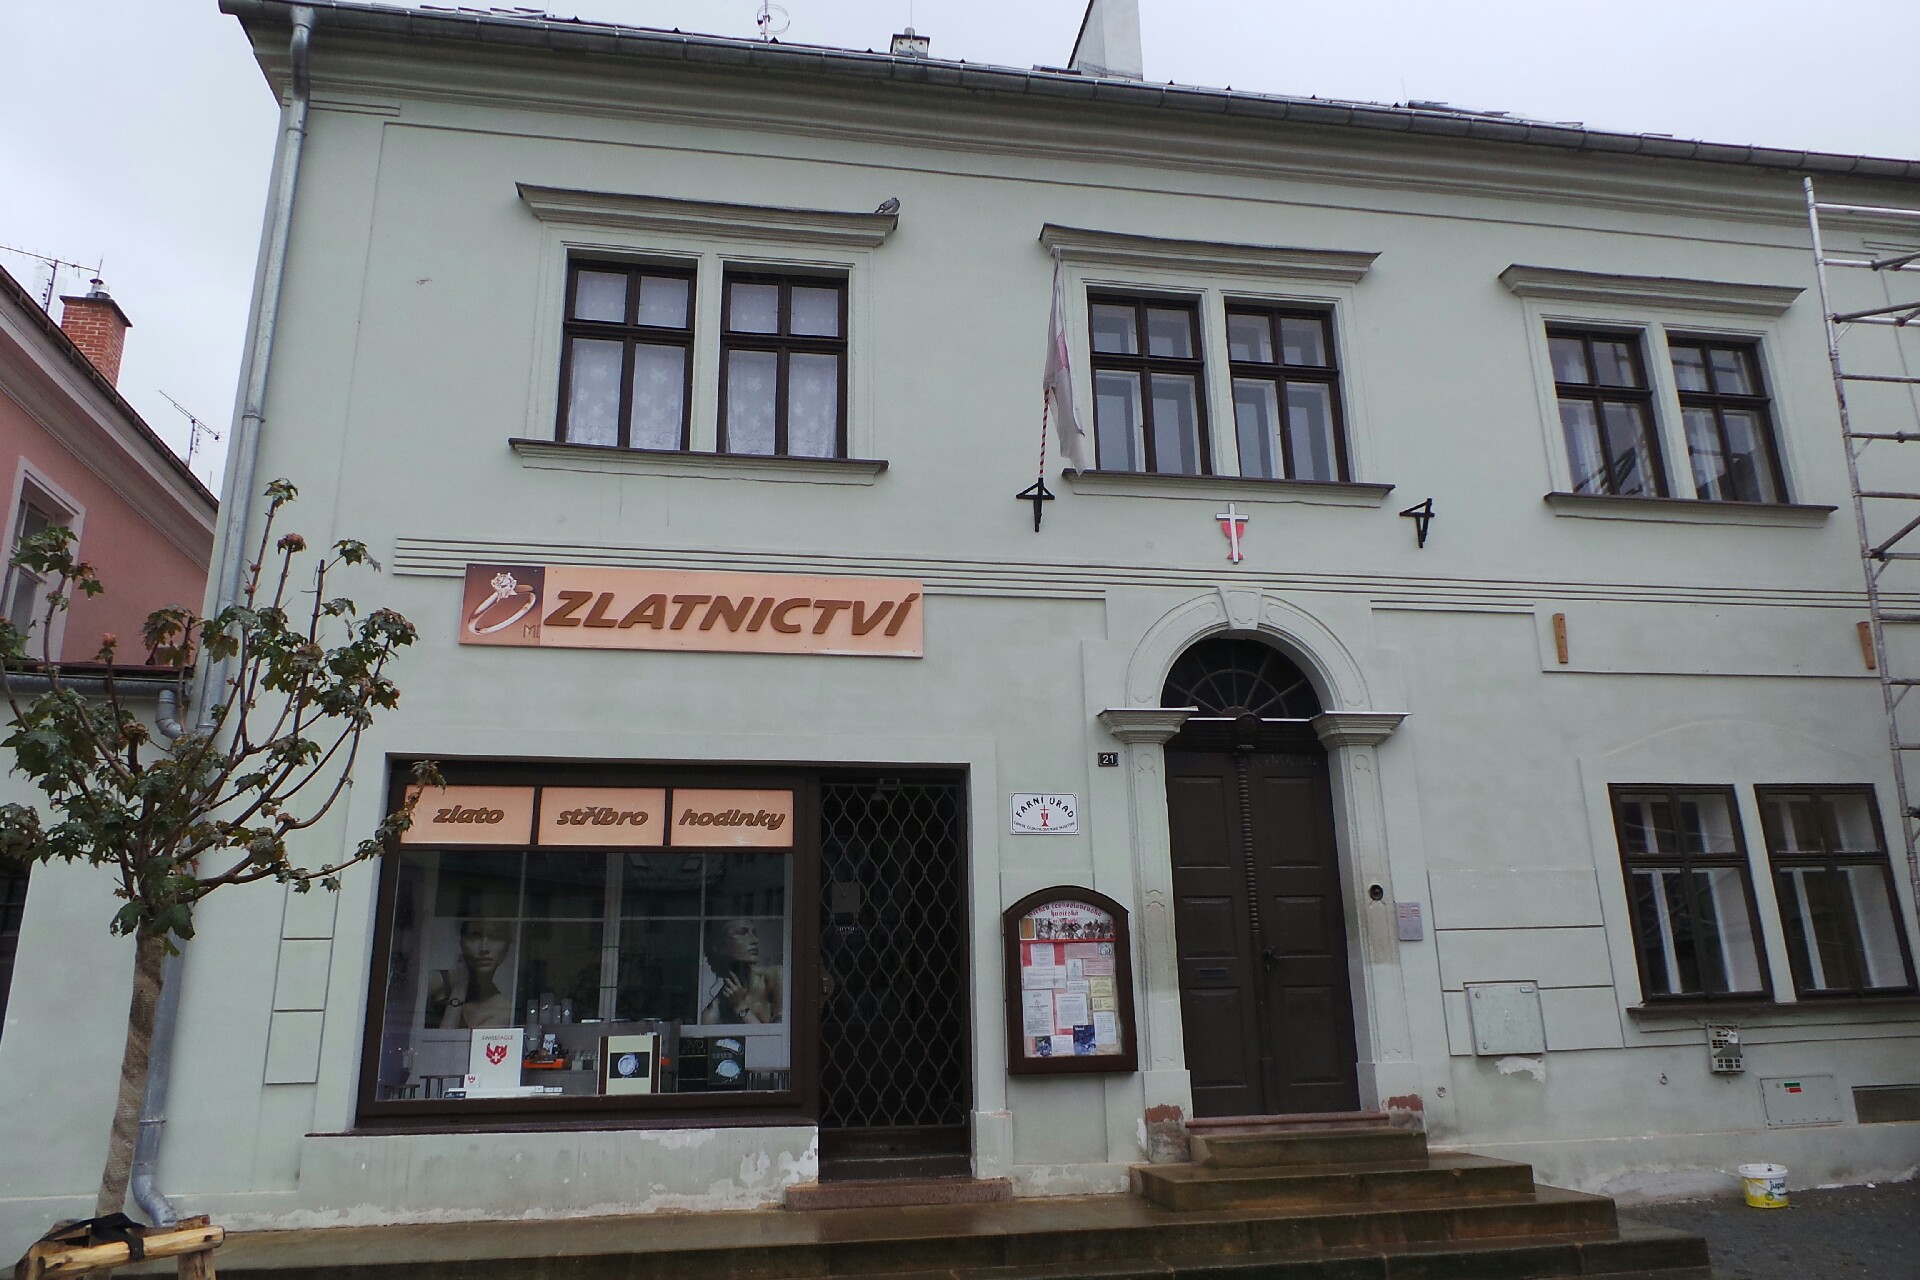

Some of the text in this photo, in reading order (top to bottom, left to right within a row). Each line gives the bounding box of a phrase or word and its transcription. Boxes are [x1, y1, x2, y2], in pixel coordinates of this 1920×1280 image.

[543, 590, 919, 636] ZLATNICTVÍ
[1102, 754, 1114, 764] 21
[433, 805, 505, 824] zlato
[1016, 796, 1044, 818] FARNÍ
[678, 808, 786, 831] hodinky
